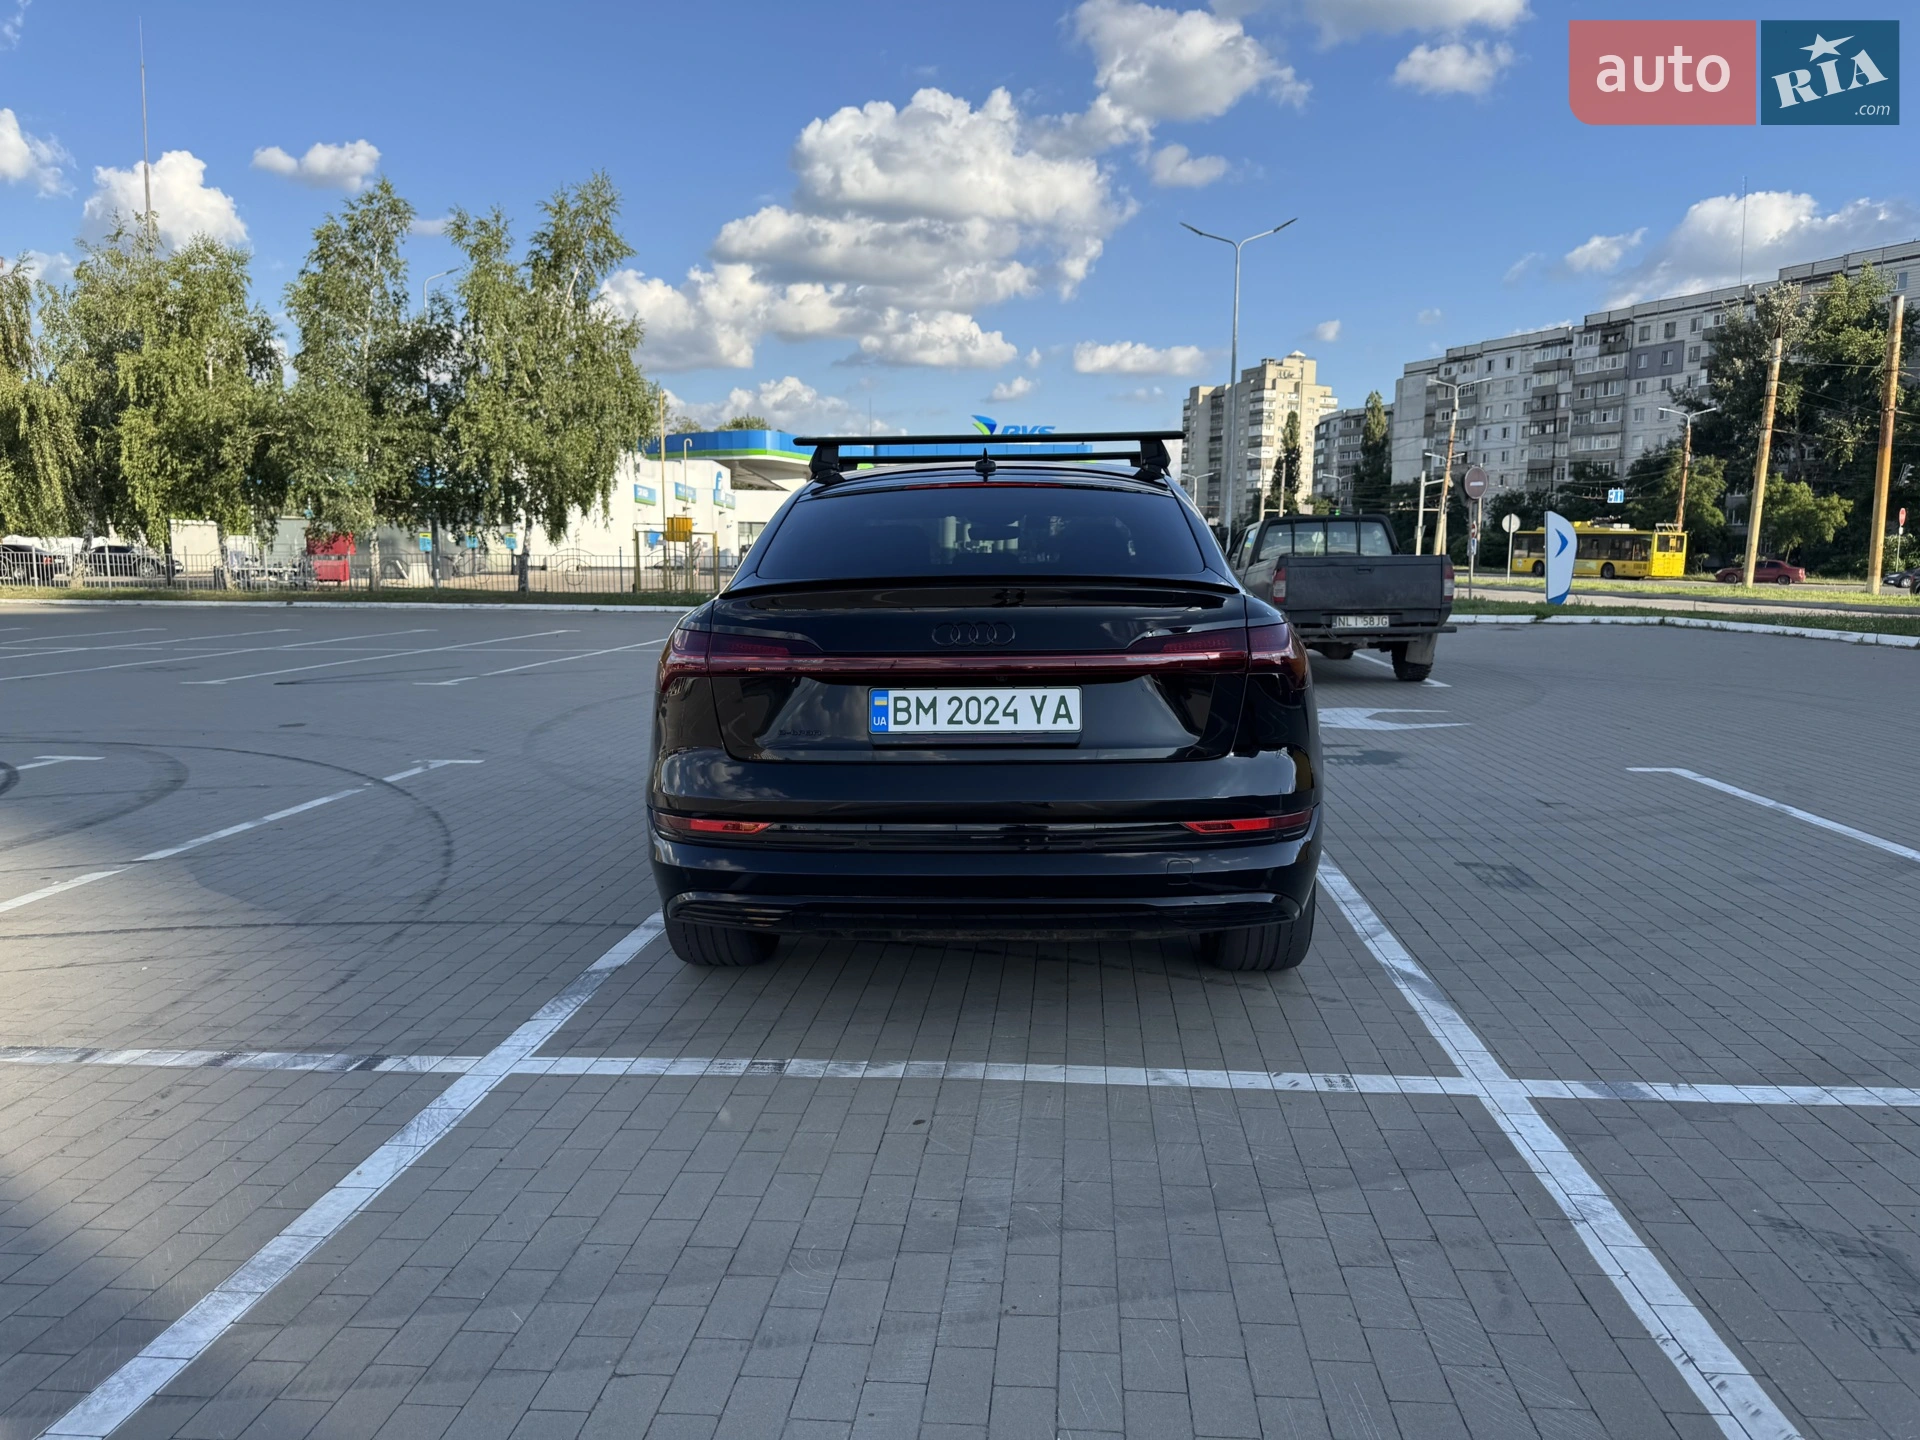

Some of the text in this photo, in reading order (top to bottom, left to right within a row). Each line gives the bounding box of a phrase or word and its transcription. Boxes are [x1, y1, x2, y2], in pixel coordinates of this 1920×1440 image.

[893, 695, 1074, 725] BM 2024 YA
[873, 716, 887, 726] UA
